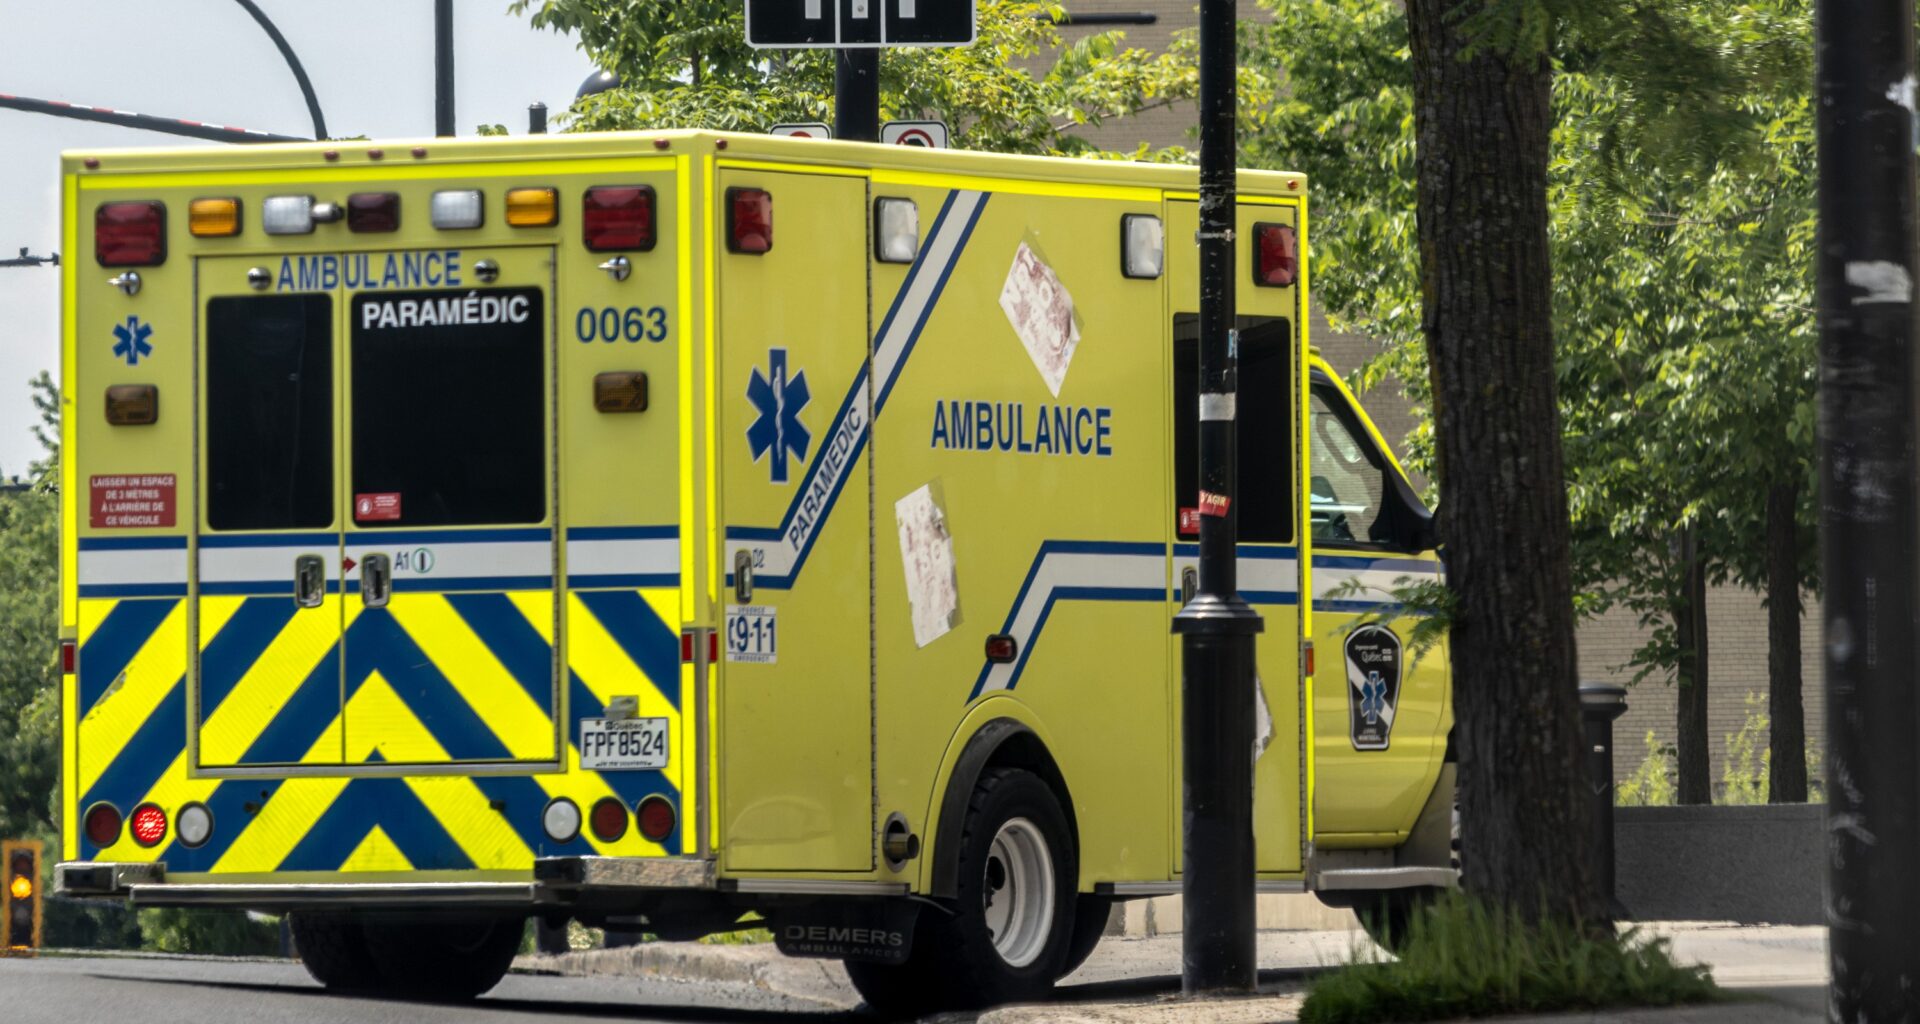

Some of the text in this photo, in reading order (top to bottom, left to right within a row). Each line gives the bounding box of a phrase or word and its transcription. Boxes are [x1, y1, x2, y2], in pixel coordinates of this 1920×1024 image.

[277, 251, 462, 291] AMBULANCE
[362, 290, 529, 329] PARAMÉDIC
[576, 306, 667, 343] 0063
[931, 400, 1112, 456] AMBULANCE
[92, 476, 174, 487] LAISSER UN ESPACE
[105, 490, 117, 500] DE
[152, 501, 165, 512] DE
[394, 552, 409, 570] A1
[583, 730, 664, 757] FPF8524
[785, 925, 904, 946] DEMERS
